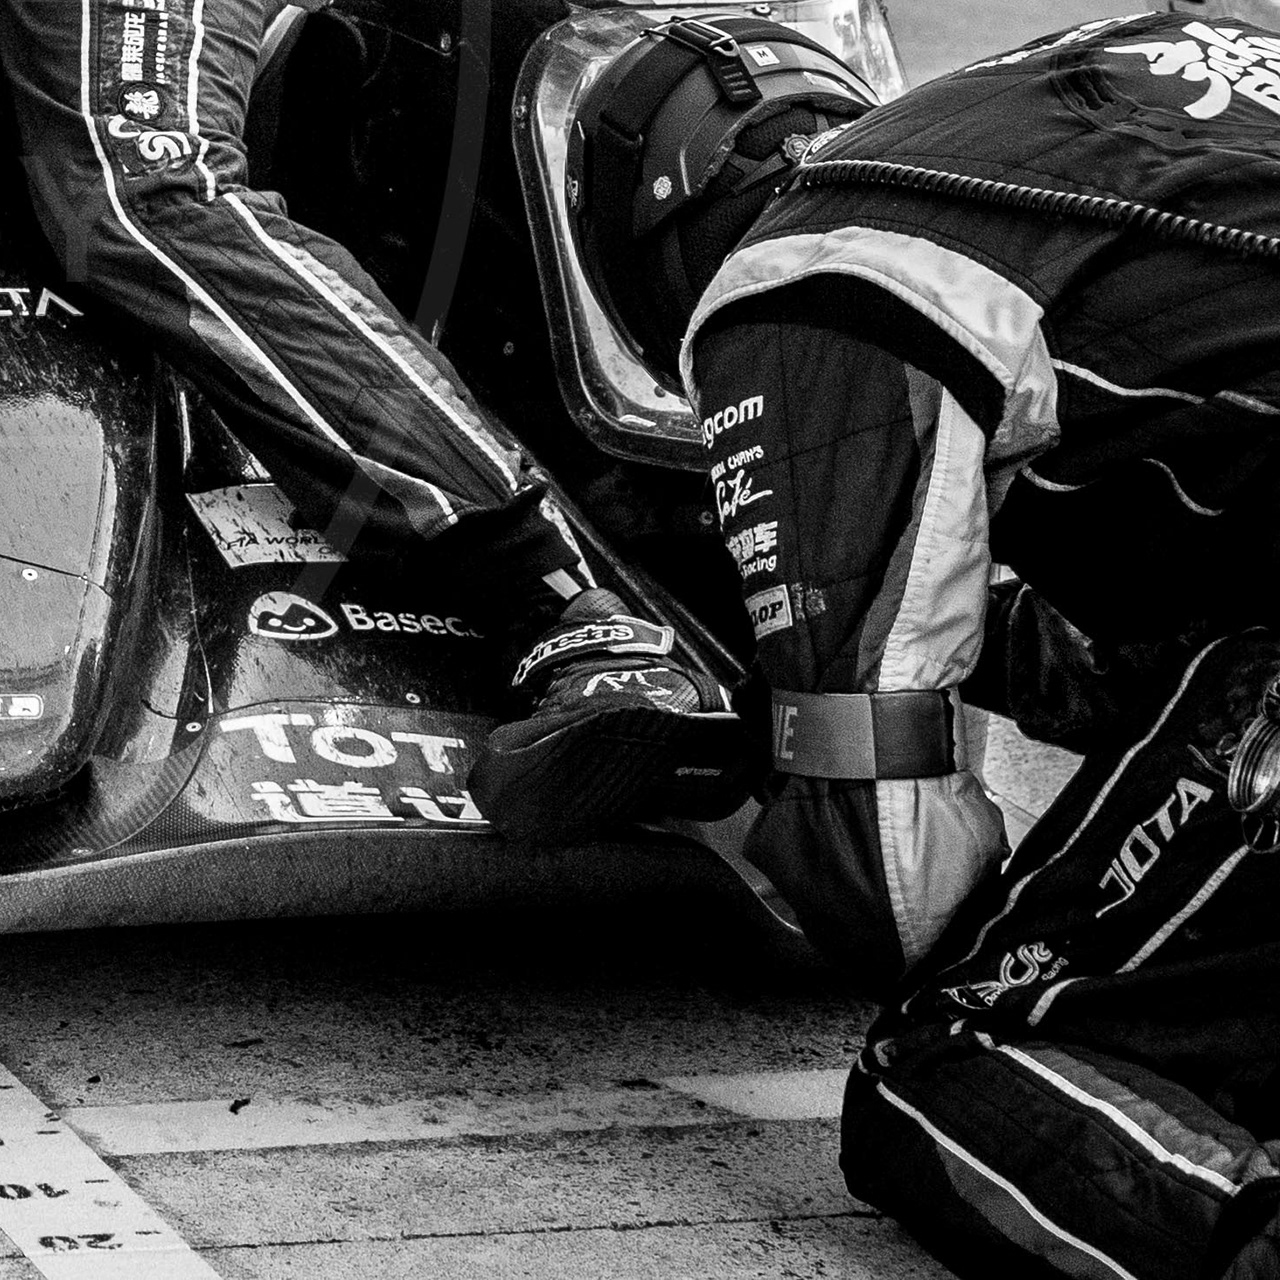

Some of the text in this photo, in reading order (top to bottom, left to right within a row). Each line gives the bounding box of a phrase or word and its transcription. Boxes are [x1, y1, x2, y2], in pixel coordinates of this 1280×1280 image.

[265, 535, 327, 546] WORL
[340, 604, 485, 638] Basec
[220, 712, 466, 773] TOT
[1095, 777, 1214, 918] JOTA
